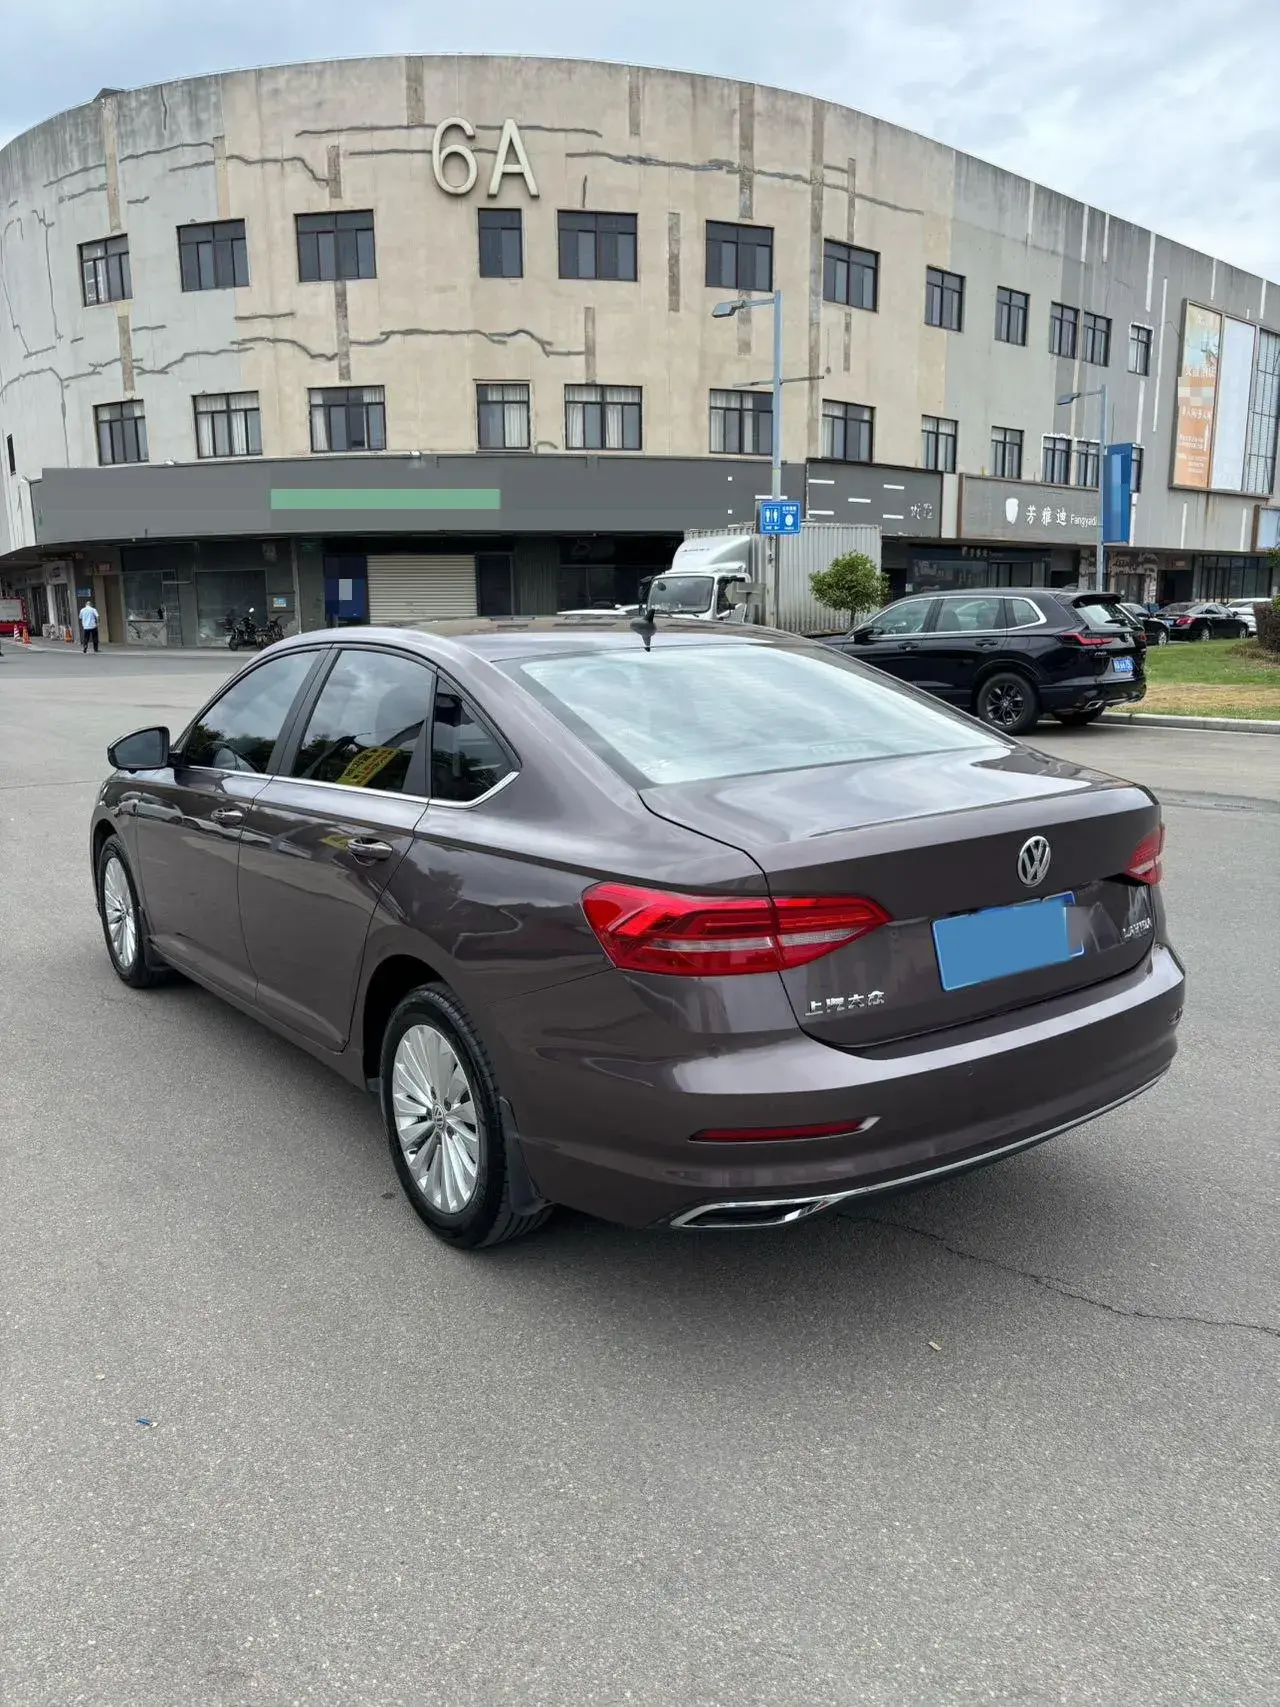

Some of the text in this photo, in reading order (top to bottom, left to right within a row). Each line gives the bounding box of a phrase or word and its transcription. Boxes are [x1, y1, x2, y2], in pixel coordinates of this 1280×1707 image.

[432, 117, 540, 198] 6A
[1025, 504, 1067, 526] 芳雅迪
